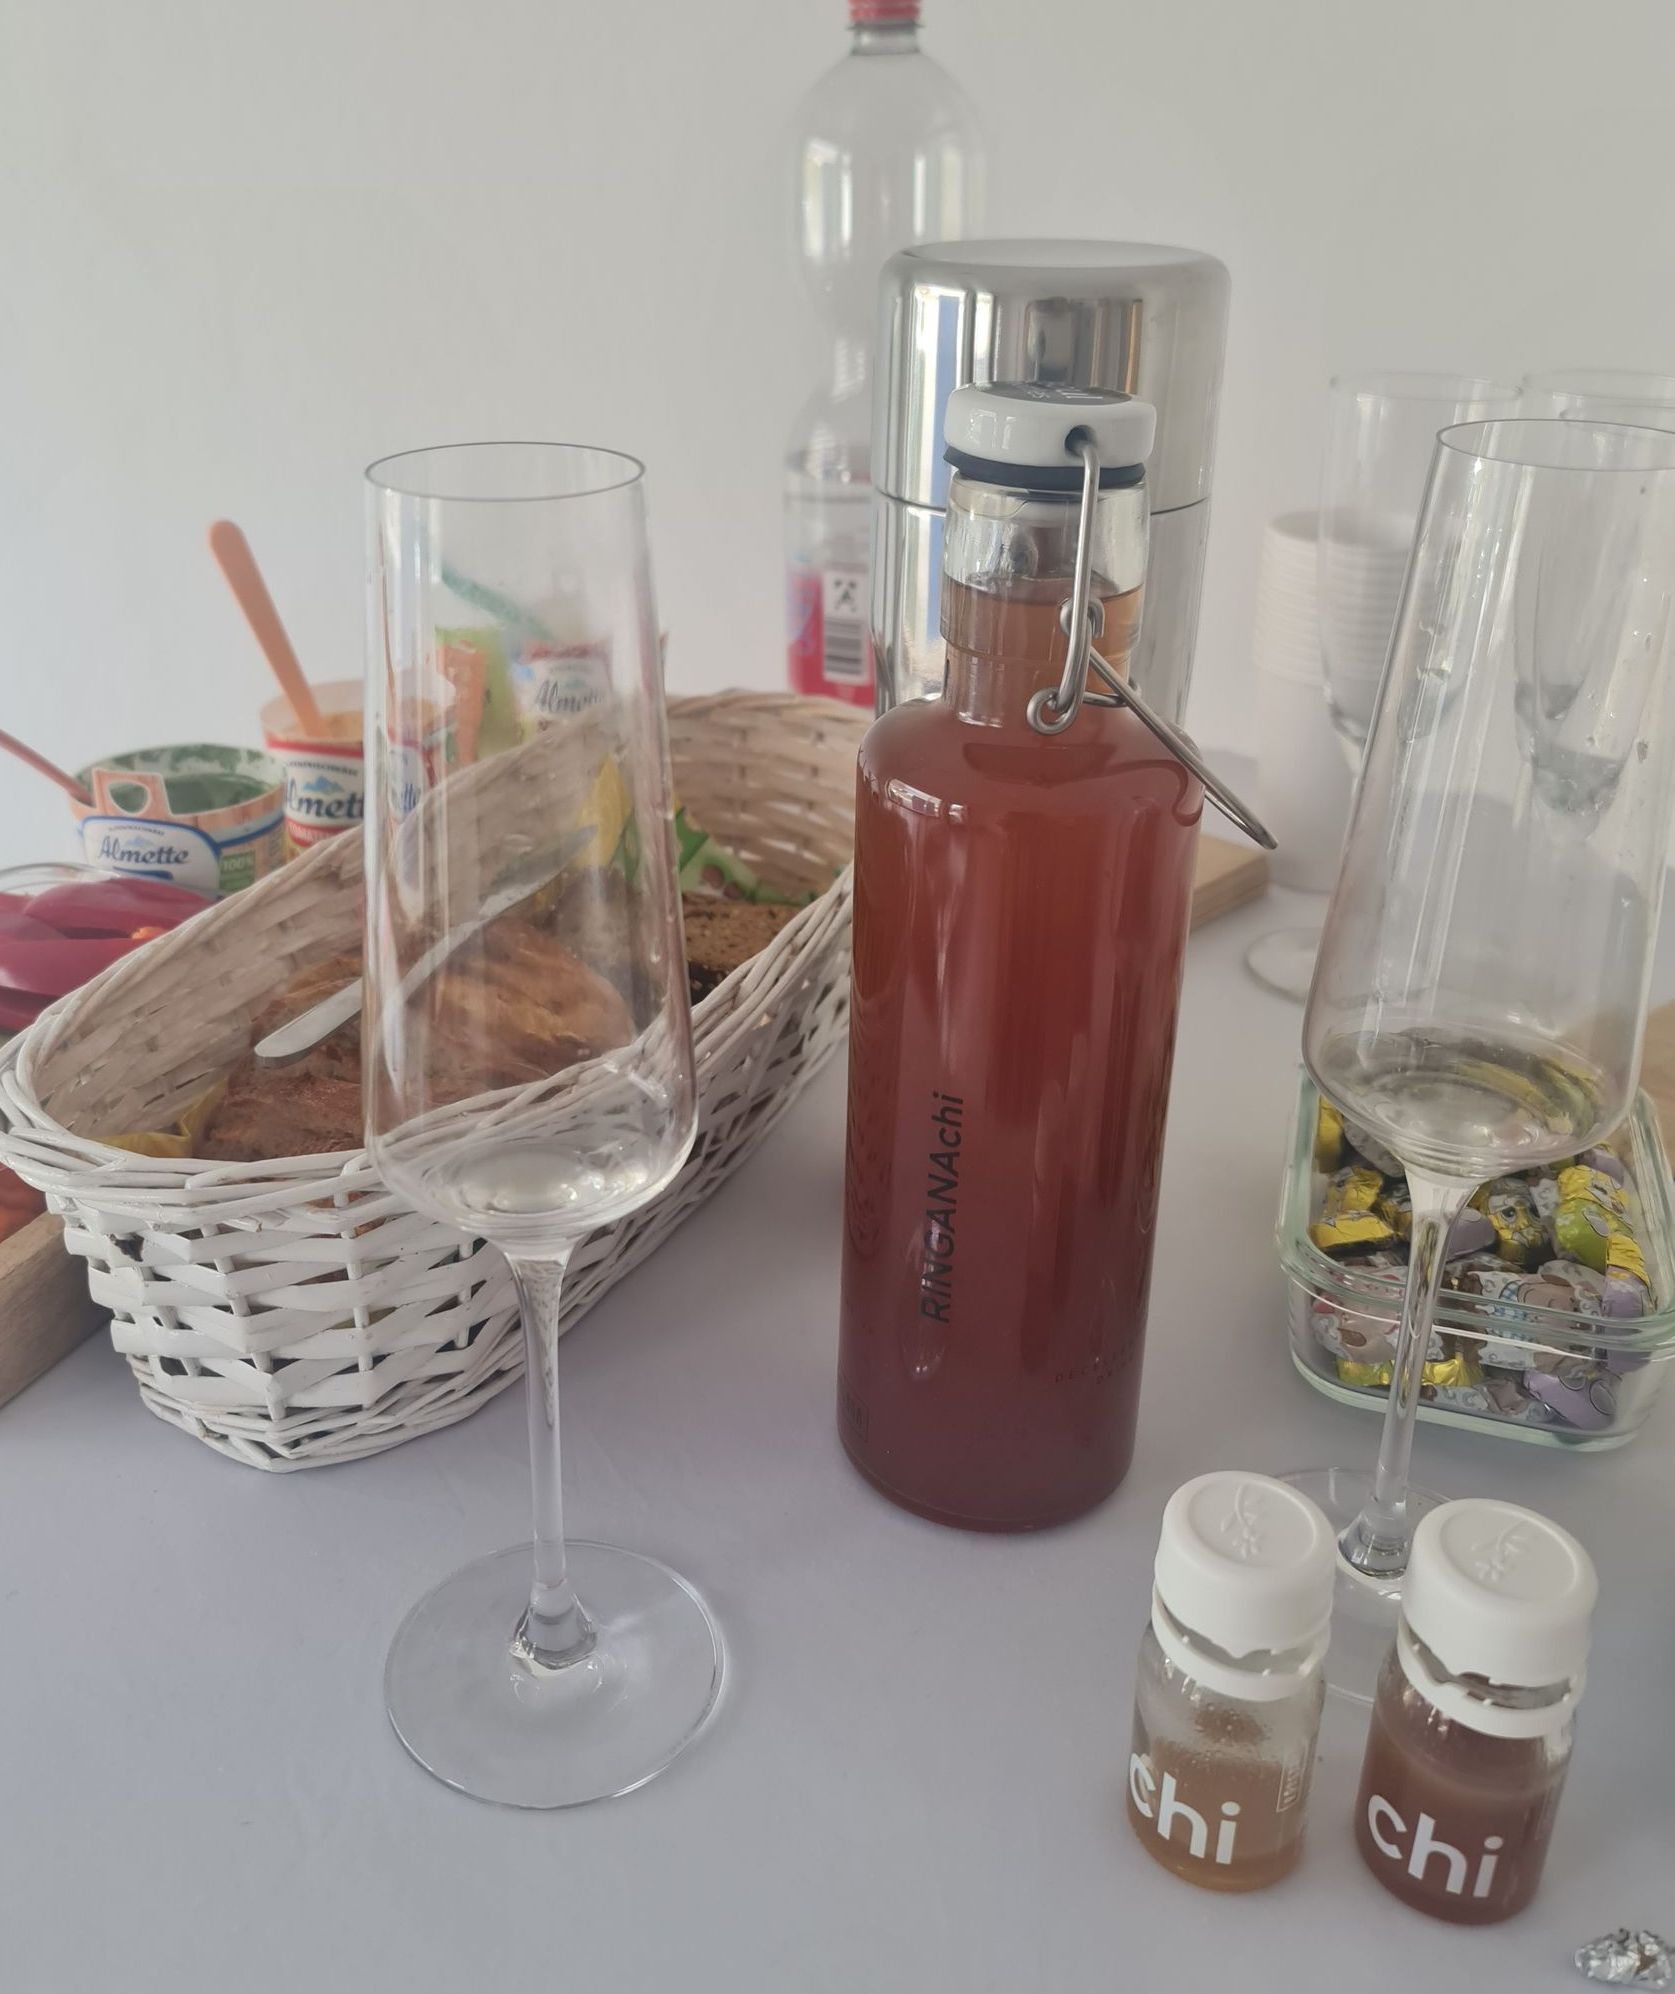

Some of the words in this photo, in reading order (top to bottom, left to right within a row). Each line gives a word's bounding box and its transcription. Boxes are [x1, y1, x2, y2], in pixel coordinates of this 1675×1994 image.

[97, 834, 189, 865] Almette
[285, 776, 366, 820] lmett
[920, 1090, 964, 1323] RINGANAchi
[1129, 1752, 1241, 1865] chi
[1367, 1794, 1503, 1898] chi
